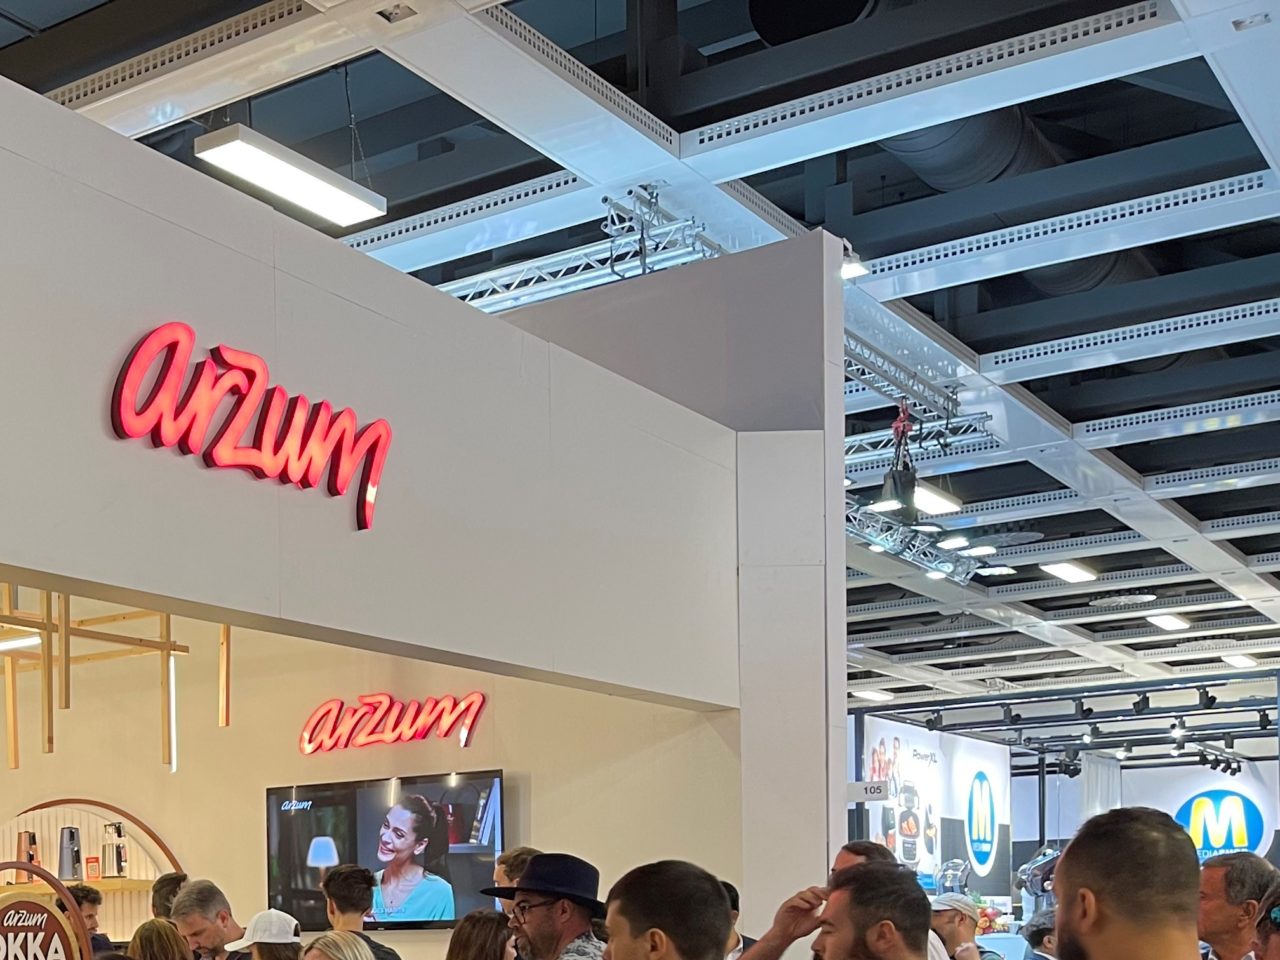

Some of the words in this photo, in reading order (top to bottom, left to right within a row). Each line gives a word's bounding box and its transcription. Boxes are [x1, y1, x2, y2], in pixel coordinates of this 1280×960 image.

[111, 321, 392, 531] arzum
[300, 691, 486, 755] arzum
[863, 785, 882, 795] 105
[3, 909, 48, 930] arzum
